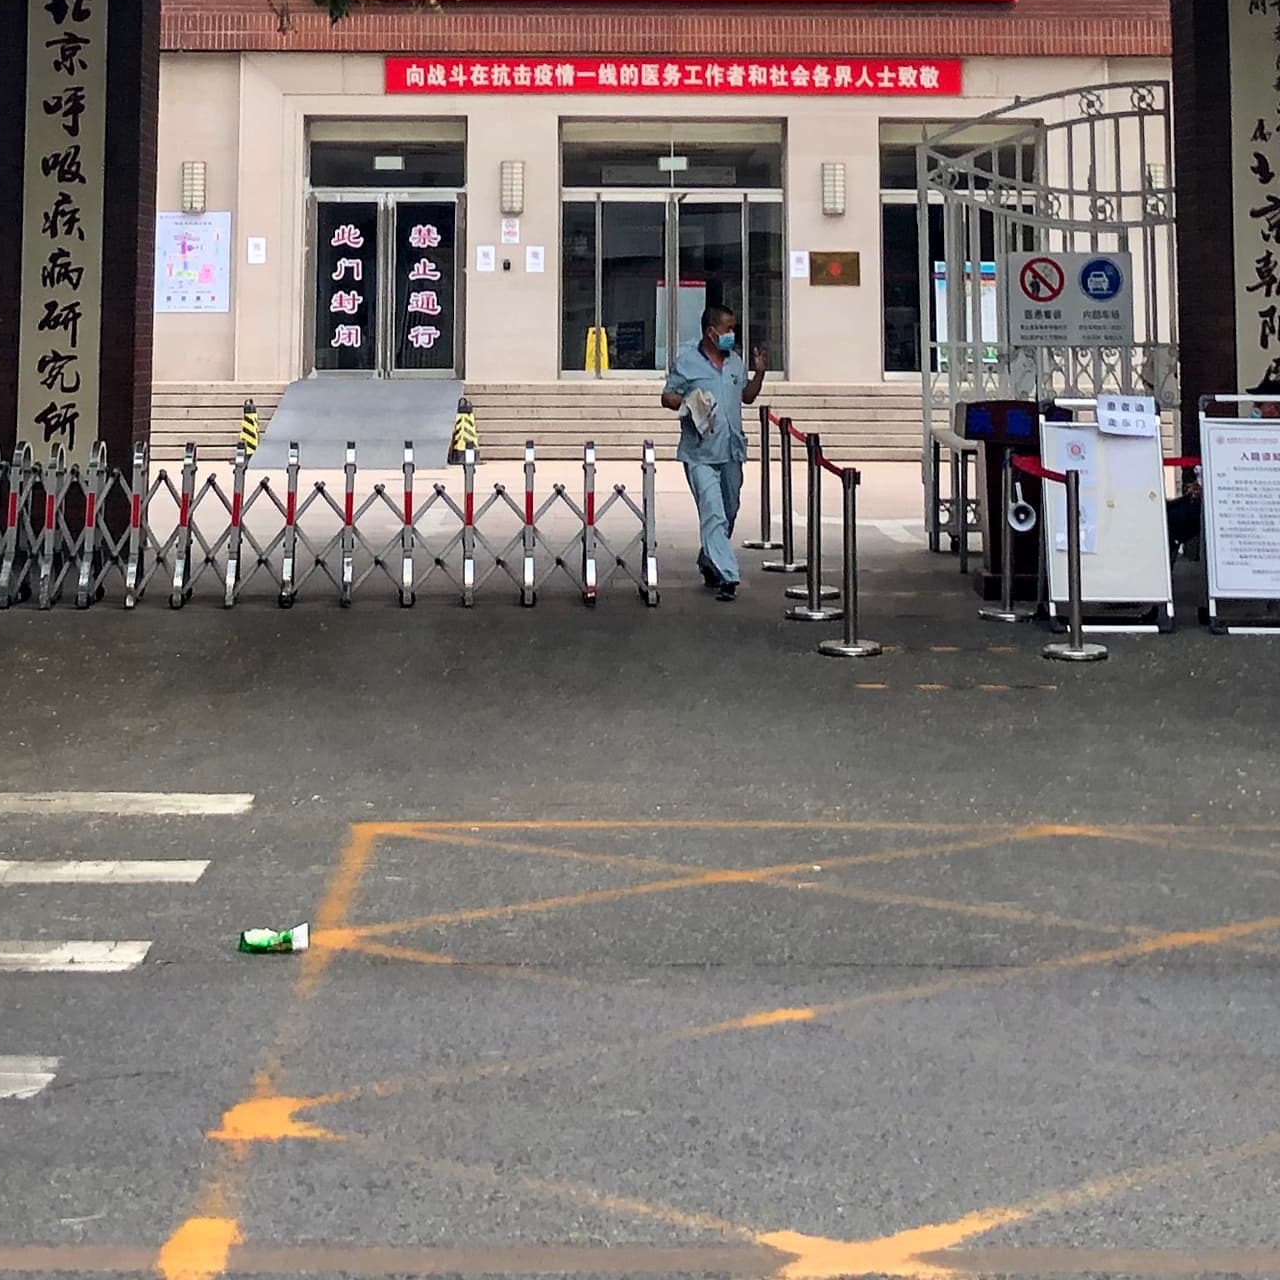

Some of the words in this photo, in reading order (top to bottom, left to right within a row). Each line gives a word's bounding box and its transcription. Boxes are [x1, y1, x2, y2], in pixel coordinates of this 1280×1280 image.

[406, 63, 940, 88] 向战斗在抗击疫情一线的医务工作者和社会各界人士致敬
[330, 224, 364, 348] 此门封闭
[408, 225, 441, 348] 禁止通行
